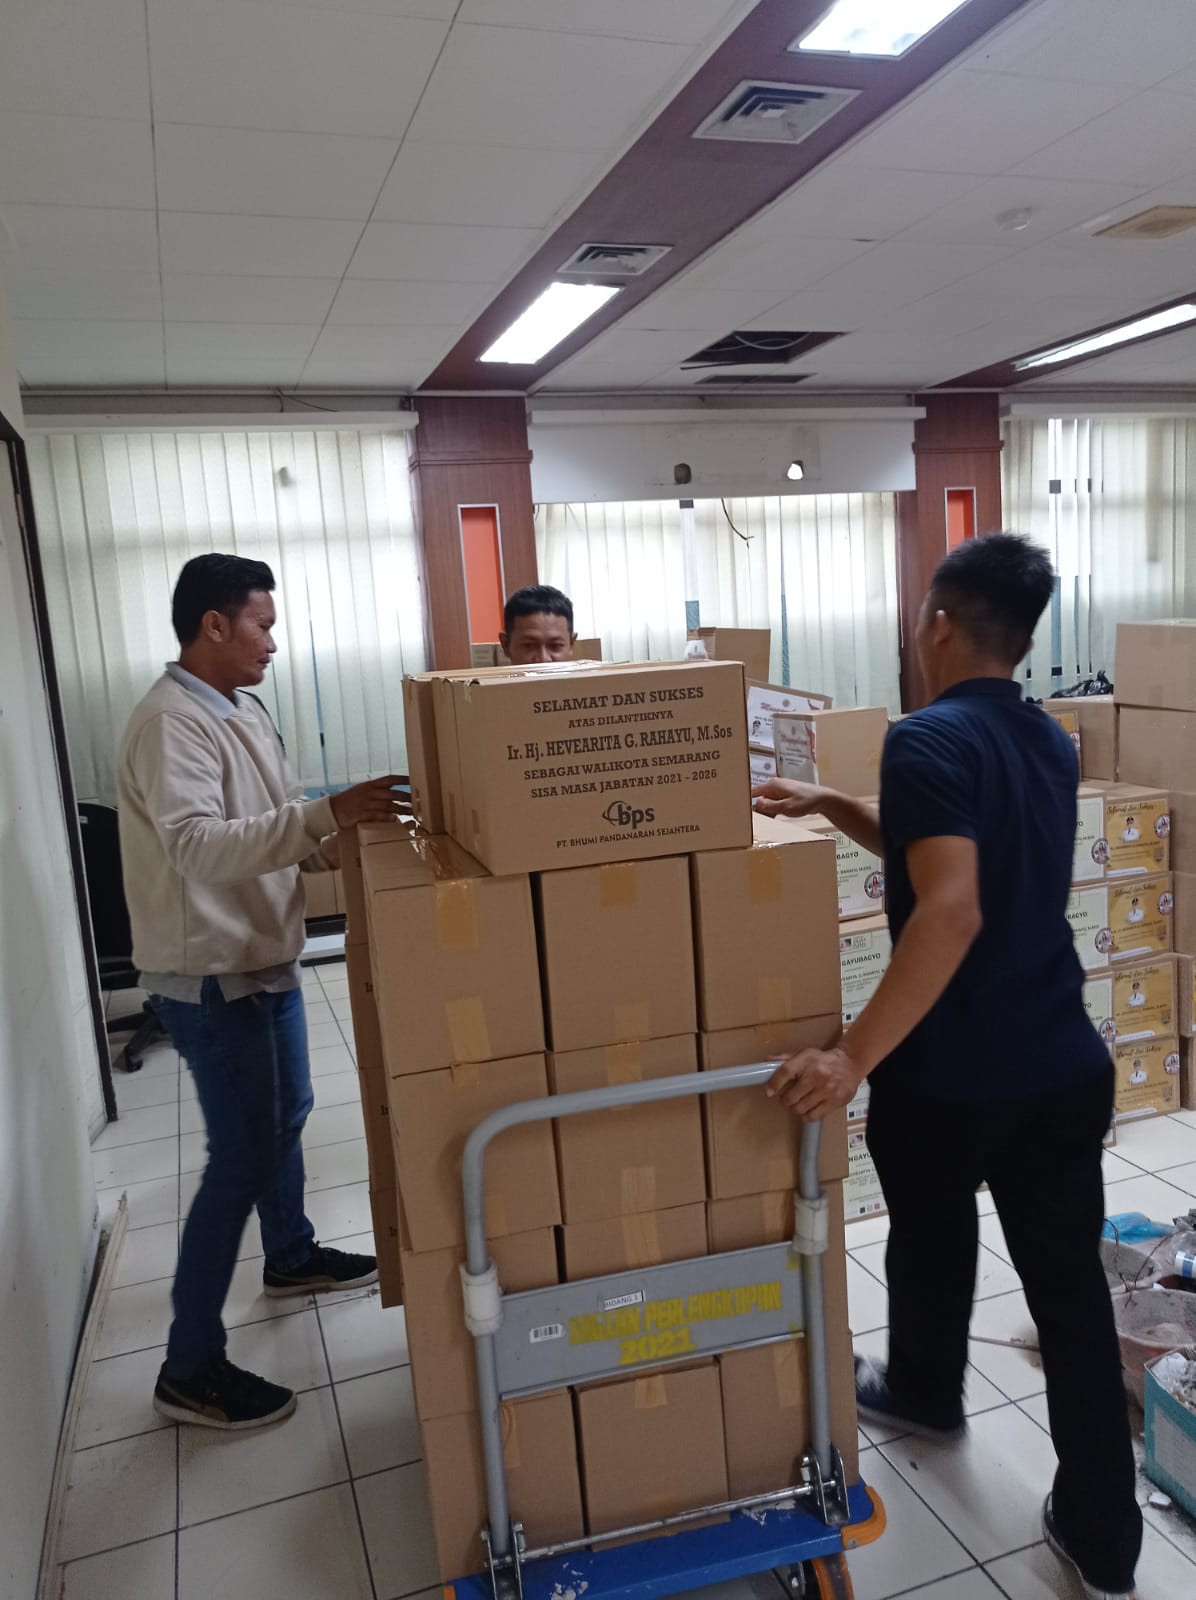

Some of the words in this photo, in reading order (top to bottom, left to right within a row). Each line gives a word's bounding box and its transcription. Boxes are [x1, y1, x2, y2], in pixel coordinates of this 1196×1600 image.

[533, 696, 608, 714] SELAMAT
[612, 691, 645, 706] DAN
[650, 687, 704, 703] SUKSES
[568, 717, 595, 728] ATAS
[597, 710, 674, 726] DILANTIKNYA
[507, 744, 523, 760] Ir.
[525, 743, 544, 762] Hj.
[546, 734, 621, 756] HEVEARITA
[625, 733, 638, 748] G.
[640, 727, 694, 746] RAHAYU,
[697, 724, 733, 740] M.Sos
[524, 765, 580, 781] SEBAGAI
[582, 759, 649, 774] WALIKOTA
[651, 750, 720, 766] SEMARANG
[531, 787, 558, 798] SISA
[561, 782, 597, 795] MASA
[600, 776, 654, 793] JABATAN
[657, 773, 682, 785] 2021
[692, 769, 717, 782] 2026
[618, 803, 655, 829] bps
[557, 840, 568, 848] PT.
[570, 836, 597, 847] BHUMI
[600, 829, 655, 843] PANDANARAN
[657, 825, 700, 836] SEJAHTERA
[620, 1327, 695, 1365] 2021
